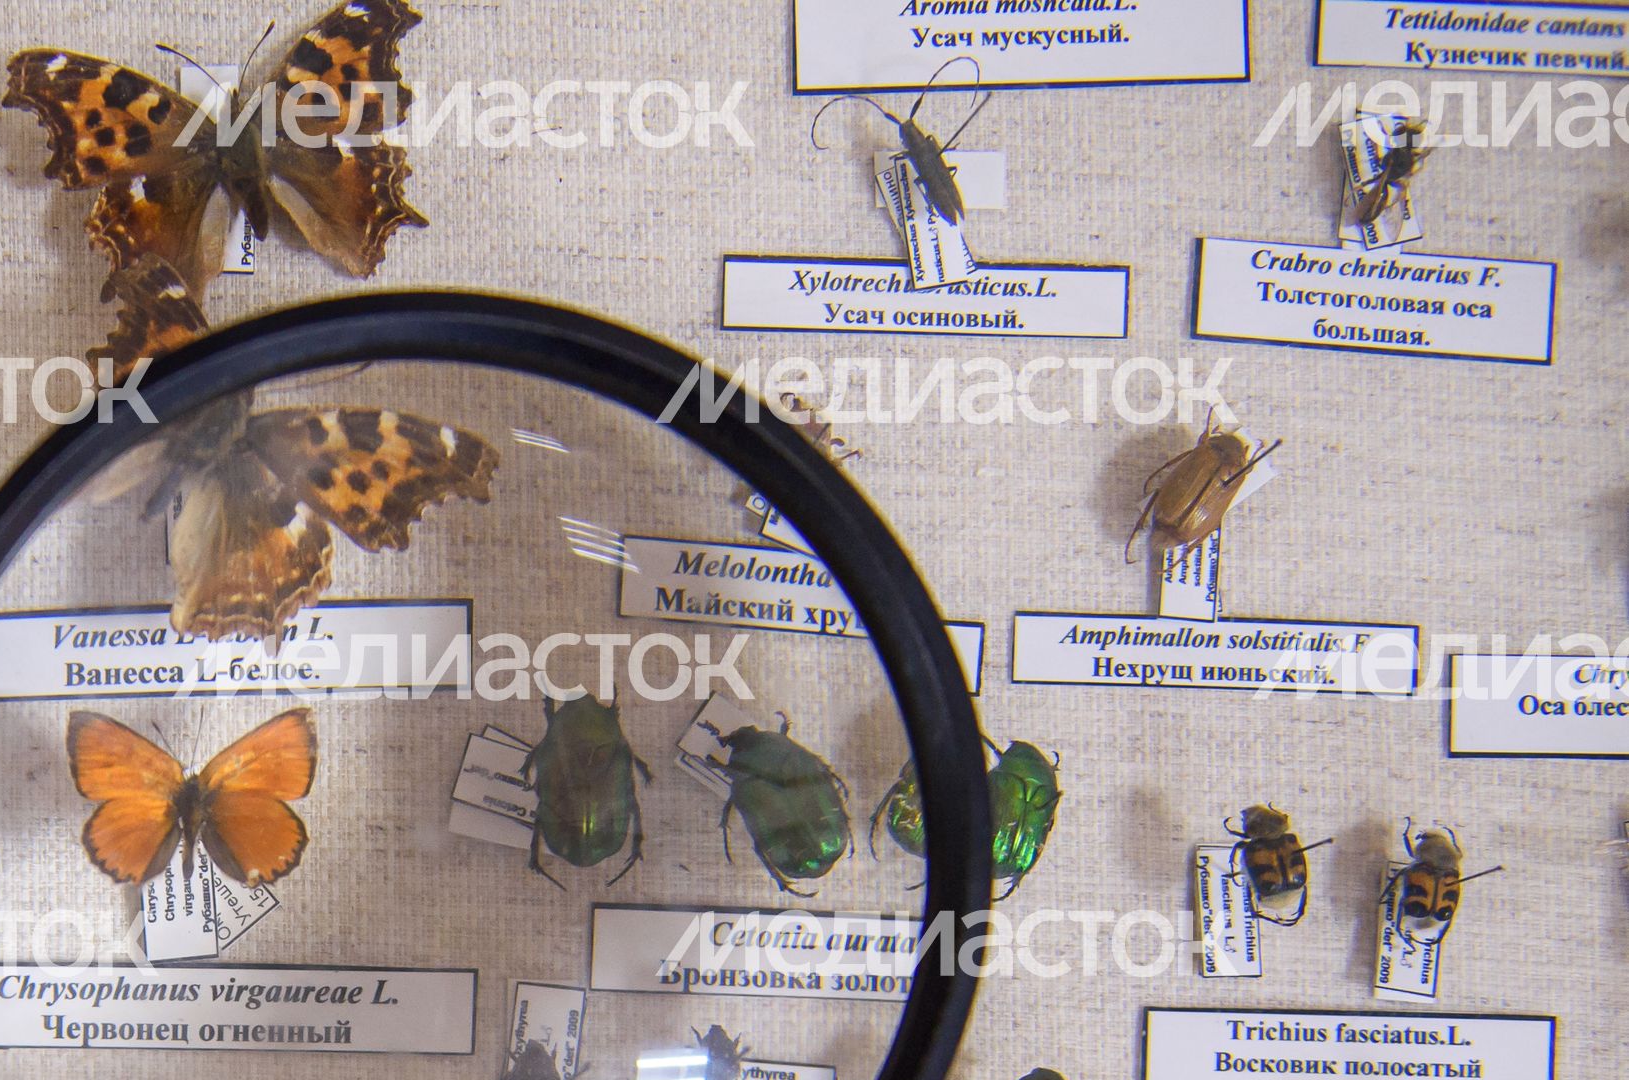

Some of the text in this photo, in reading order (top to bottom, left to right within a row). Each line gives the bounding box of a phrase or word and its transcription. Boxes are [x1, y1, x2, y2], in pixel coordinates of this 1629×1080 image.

[910, 23, 1130, 48] Усач мускусный.
[1404, 42, 1530, 70] Кузнечик
[1251, 248, 1333, 276] Crabro
[1480, 267, 1502, 287] F.
[1257, 282, 1492, 319] Толстоголовая оса
[823, 303, 1024, 332] Усач осиновый.
[1313, 318, 1431, 349] большая.
[673, 552, 833, 589] Melolontha
[655, 586, 794, 622] Майский
[52, 624, 168, 652] Vanessa
[308, 616, 334, 641] L.
[1059, 625, 1220, 651] Amphimallon
[64, 660, 183, 687] Ванесса
[1091, 655, 1195, 687] Нехрущ
[1518, 694, 1565, 718] Оса
[709, 922, 820, 950] Cetonia
[1205, 944, 1217, 973] 2009
[659, 959, 821, 992] Бронзовка
[210, 978, 363, 1010] virgaureae
[371, 980, 398, 1006] L.
[42, 1018, 353, 1048] Червонец огненный
[1227, 1020, 1471, 1048] Trichius fasciatus.L.
[1214, 1052, 1482, 1080] Восковик полосатый
